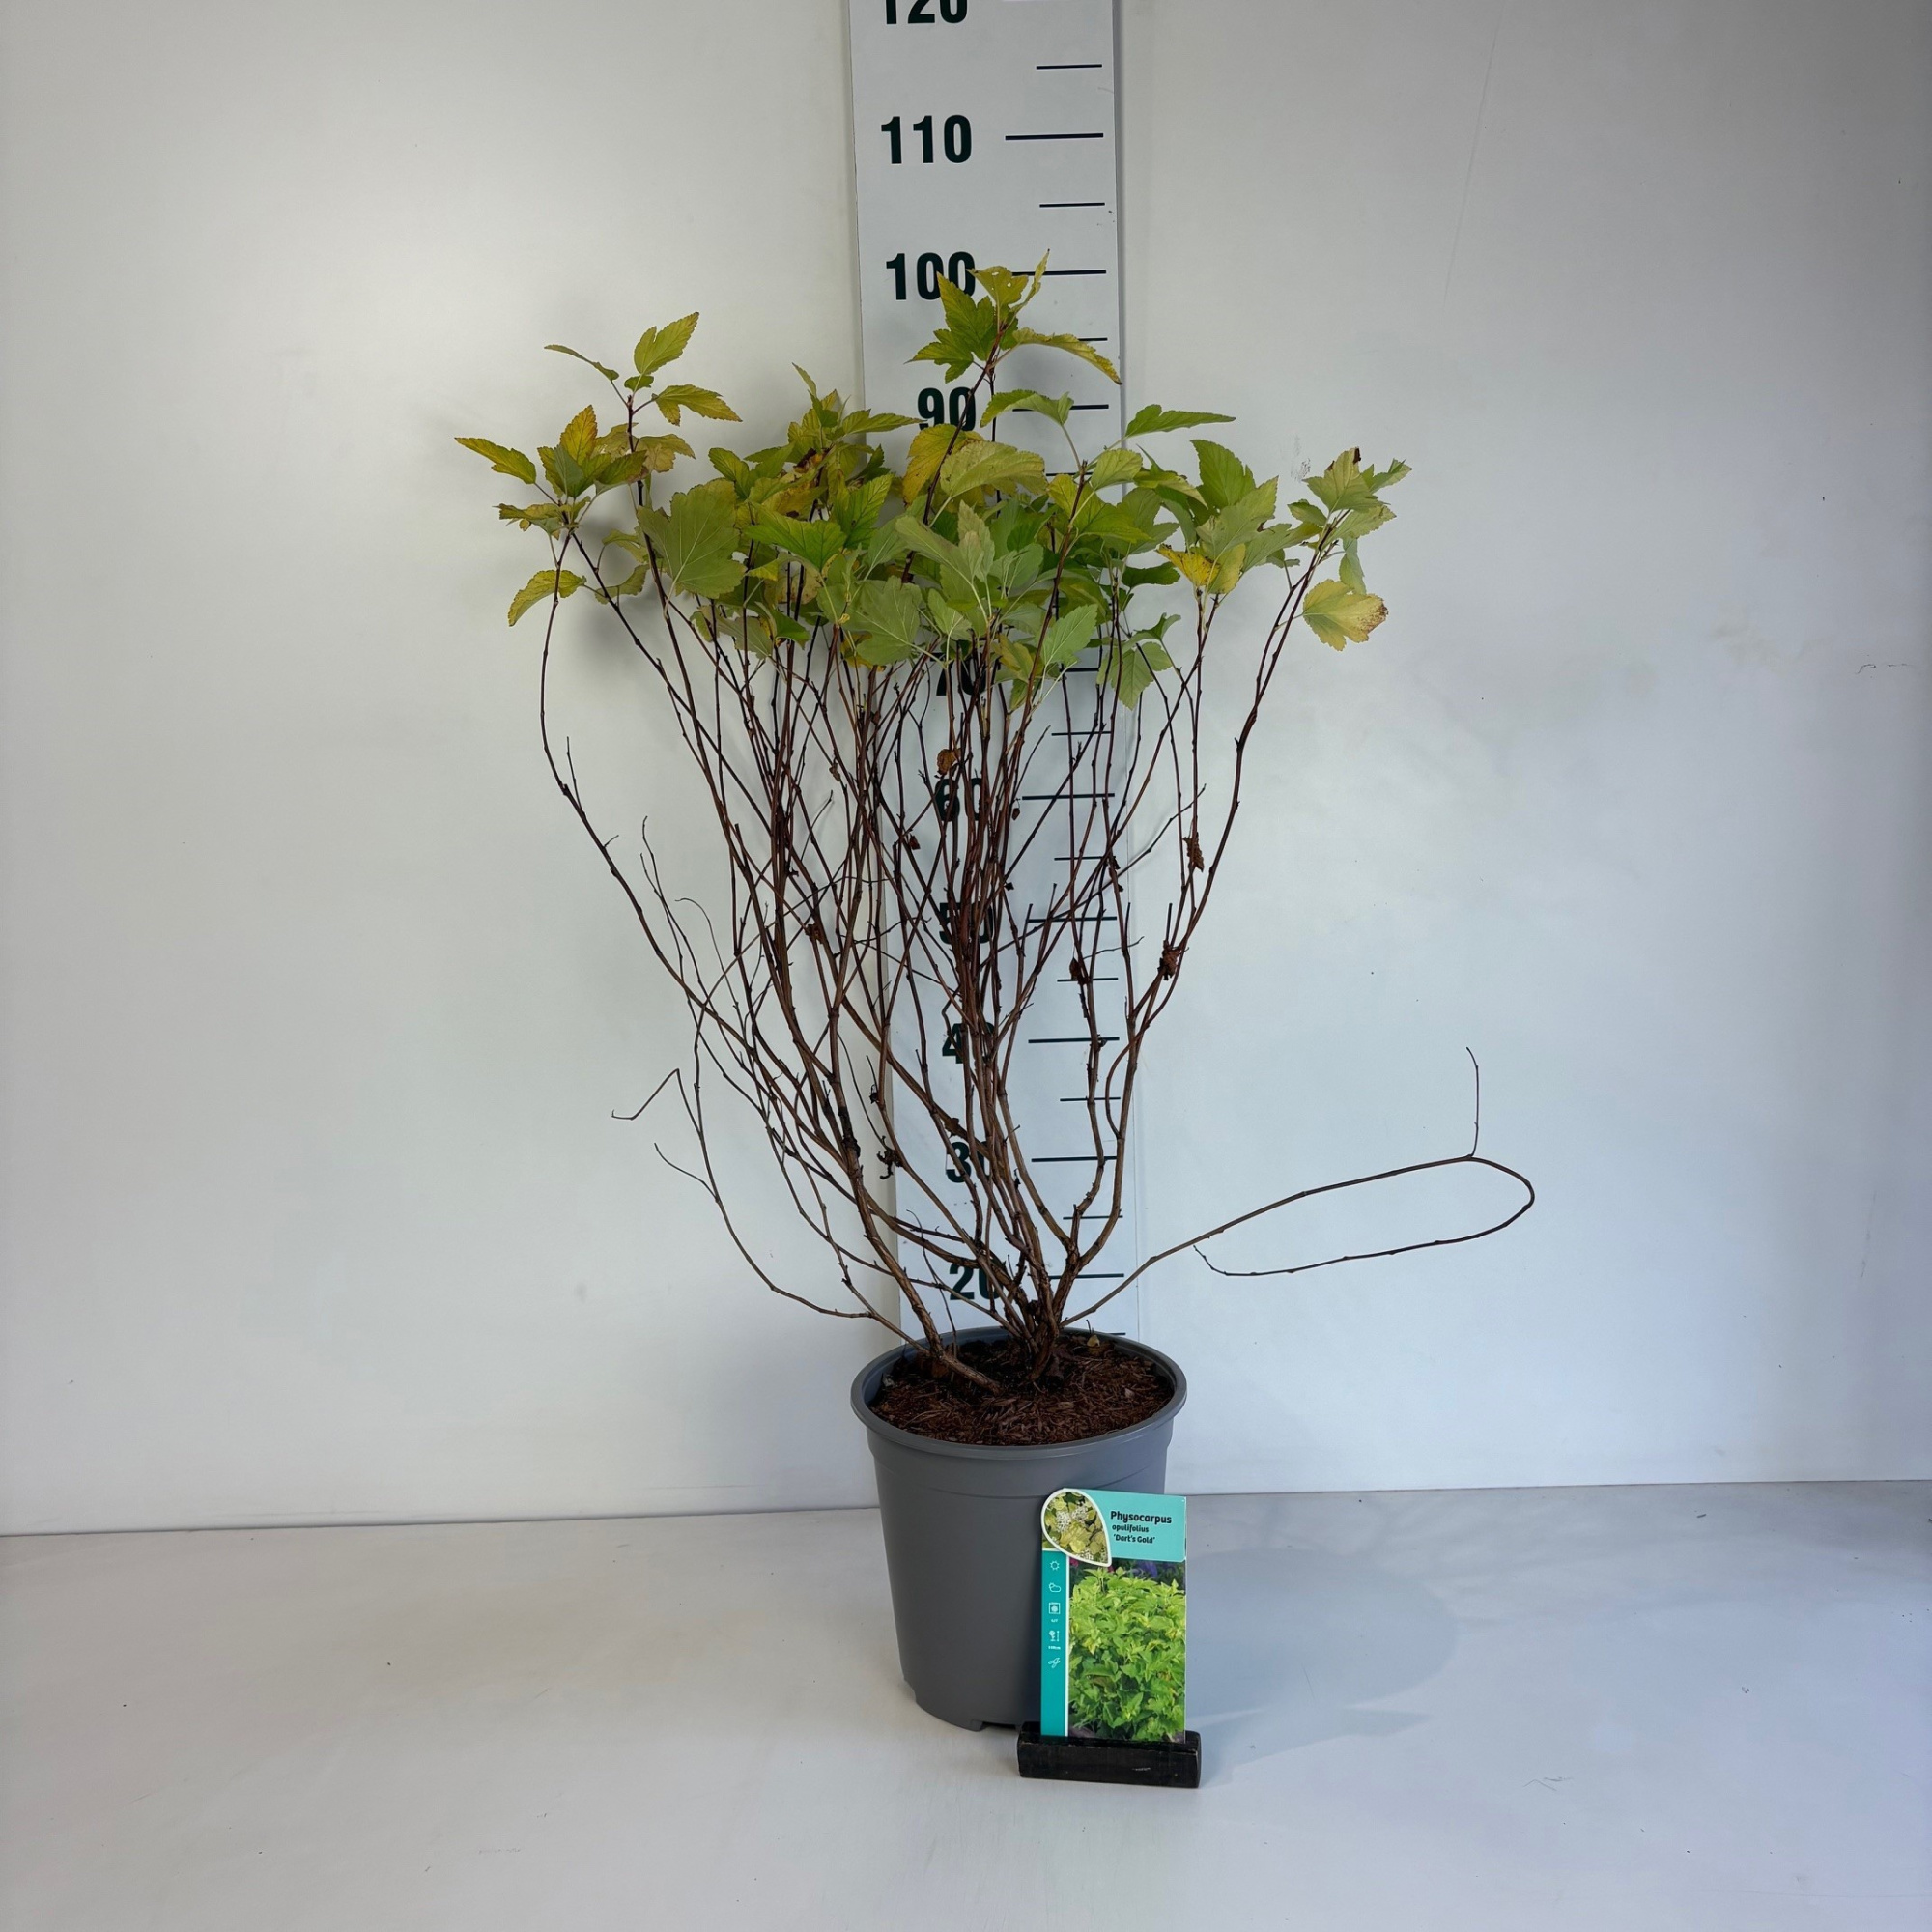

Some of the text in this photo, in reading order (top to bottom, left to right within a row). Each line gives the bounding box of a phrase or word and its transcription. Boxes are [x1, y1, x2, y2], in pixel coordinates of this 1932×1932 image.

[880, 114, 973, 164] 110
[885, 251, 977, 300] 100
[917, 386, 977, 432] 90
[1110, 1510, 1172, 1525] Physocarpus
[1112, 1523, 1150, 1533] opulifolius
